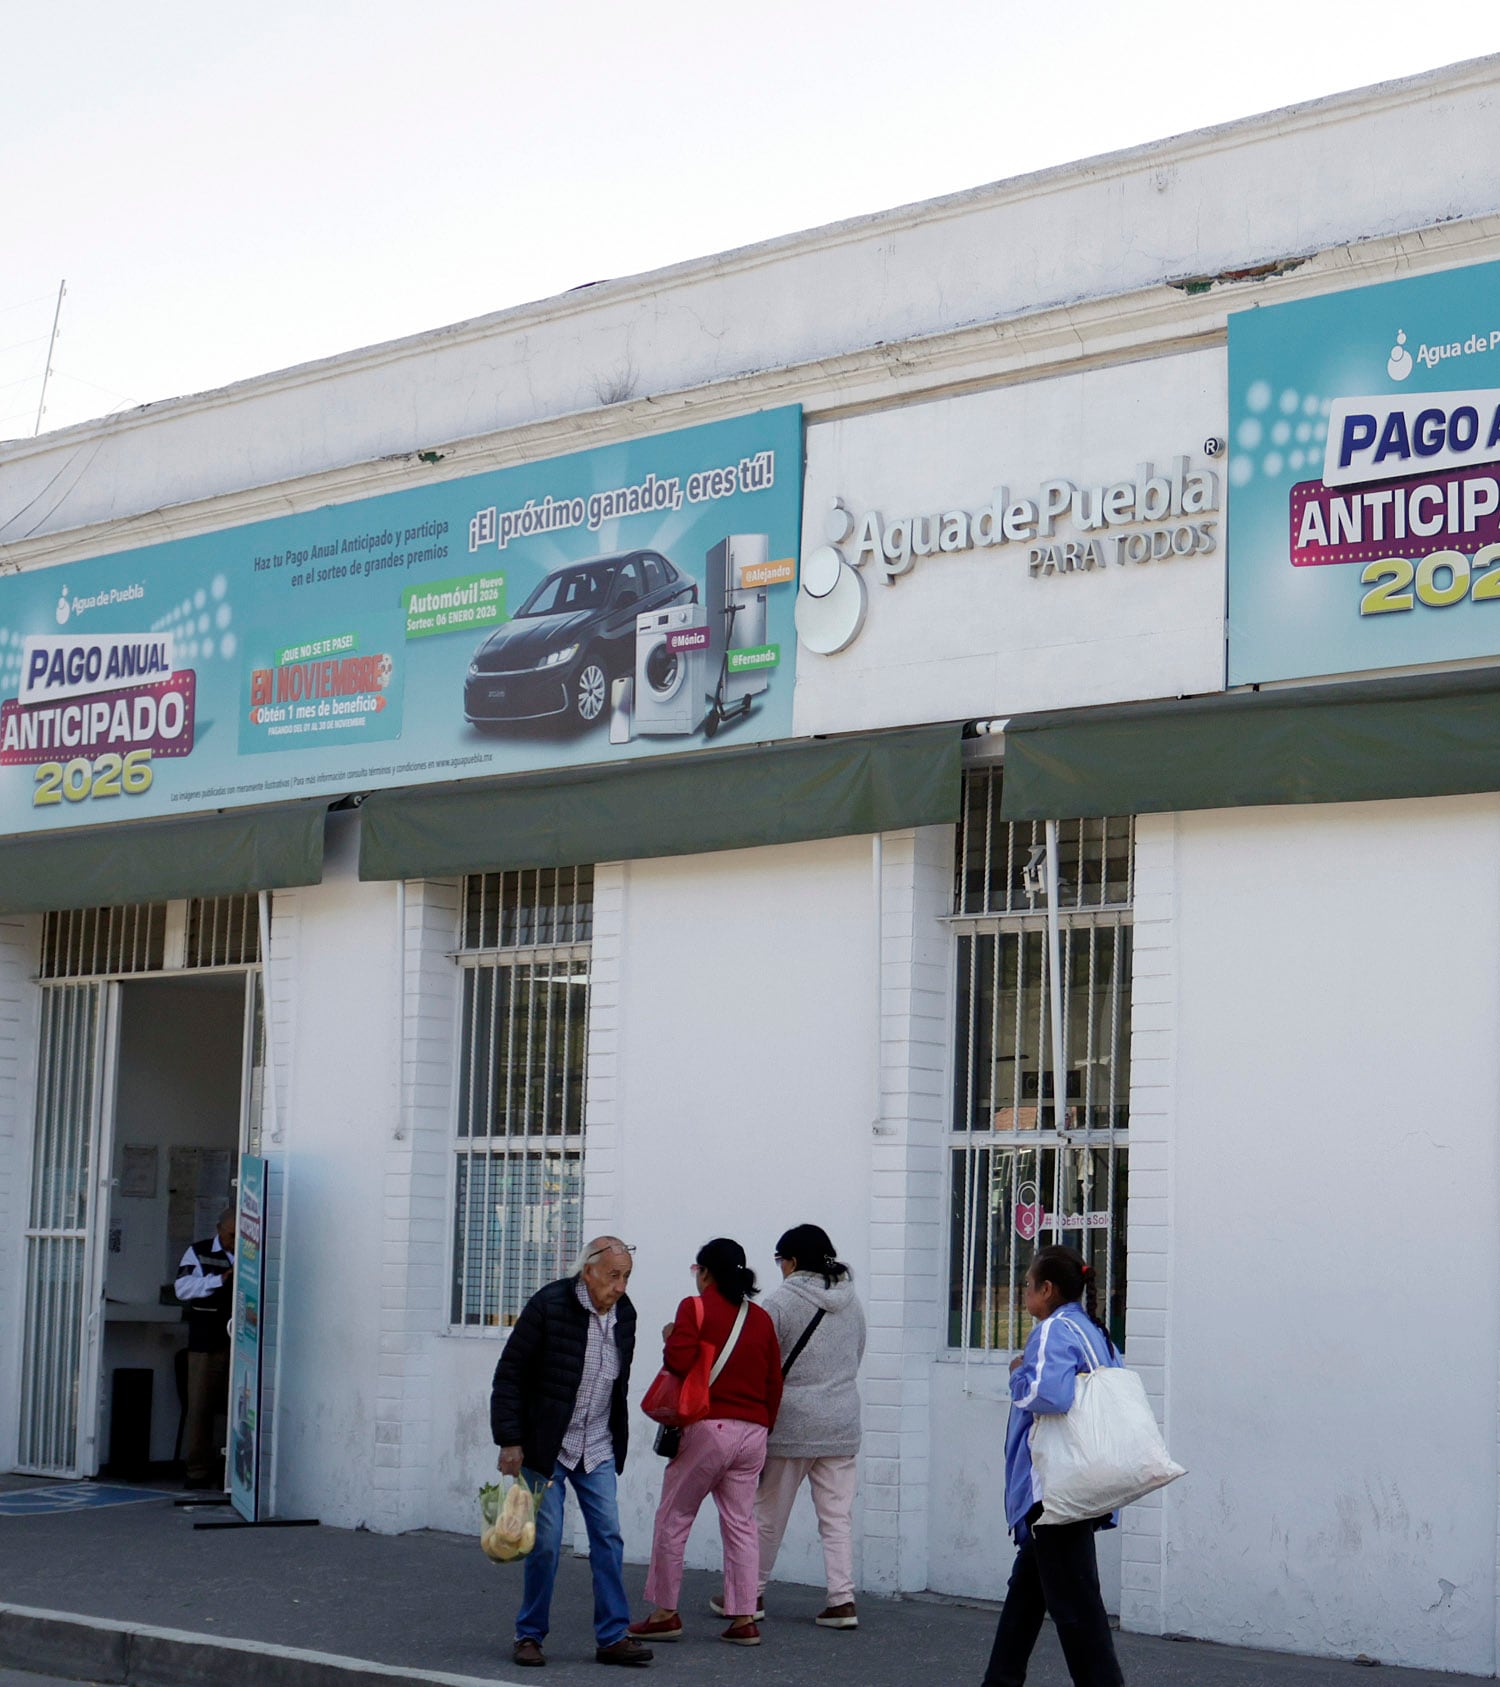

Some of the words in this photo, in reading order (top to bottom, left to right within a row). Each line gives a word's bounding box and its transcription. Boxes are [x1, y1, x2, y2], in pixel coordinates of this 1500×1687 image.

[1416, 342, 1461, 368] Agua
[1464, 334, 1487, 354] de
[1338, 406, 1479, 467] PAGO
[470, 508, 495, 549] ¡El
[500, 497, 585, 548] próximo
[588, 475, 683, 529] ganador,
[688, 466, 736, 500] eres
[738, 452, 774, 491] tú!
[254, 557, 270, 572] Haz
[273, 555, 282, 567] tu
[286, 548, 308, 567] Pago
[311, 540, 338, 560] Anual
[341, 529, 393, 553] Anticipado
[395, 530, 402, 547] y
[404, 520, 449, 543] participa
[1028, 539, 1106, 578] PARA
[1110, 521, 1218, 565] TODOS
[291, 574, 303, 587] en
[306, 568, 314, 584] el
[317, 564, 347, 581] sorteo
[350, 560, 362, 575] de
[364, 552, 404, 577] grandes
[407, 544, 448, 569] premios
[745, 565, 791, 583] @Alejandro
[71, 596, 95, 616] Agua
[96, 591, 109, 606] de
[110, 584, 144, 604] Puebla
[408, 582, 478, 614] Automóvil
[479, 577, 504, 588] Nuevo
[479, 589, 498, 601] 2026
[407, 617, 434, 631] Sorteo:
[436, 614, 447, 626] 06
[448, 608, 474, 624] ENERO
[476, 605, 497, 619] 2026
[281, 647, 299, 664] ¡QUE
[301, 644, 311, 657] NO
[313, 642, 321, 654] SE
[322, 640, 331, 651] TE
[332, 635, 353, 650] PASE!
[671, 633, 705, 648] @Mónica
[732, 649, 776, 666] @Fernanda
[27, 646, 102, 690] PAGO
[104, 643, 169, 680] ANUAL
[251, 669, 273, 706] EN
[276, 654, 384, 704] NOVIEMBRE
[3, 691, 185, 751] ANTICIPADO
[257, 706, 285, 724] Obtén
[288, 704, 294, 720] 1
[296, 704, 316, 718] mes
[318, 700, 329, 716] de
[332, 695, 377, 715] beneficio
[33, 748, 153, 807] 2026
